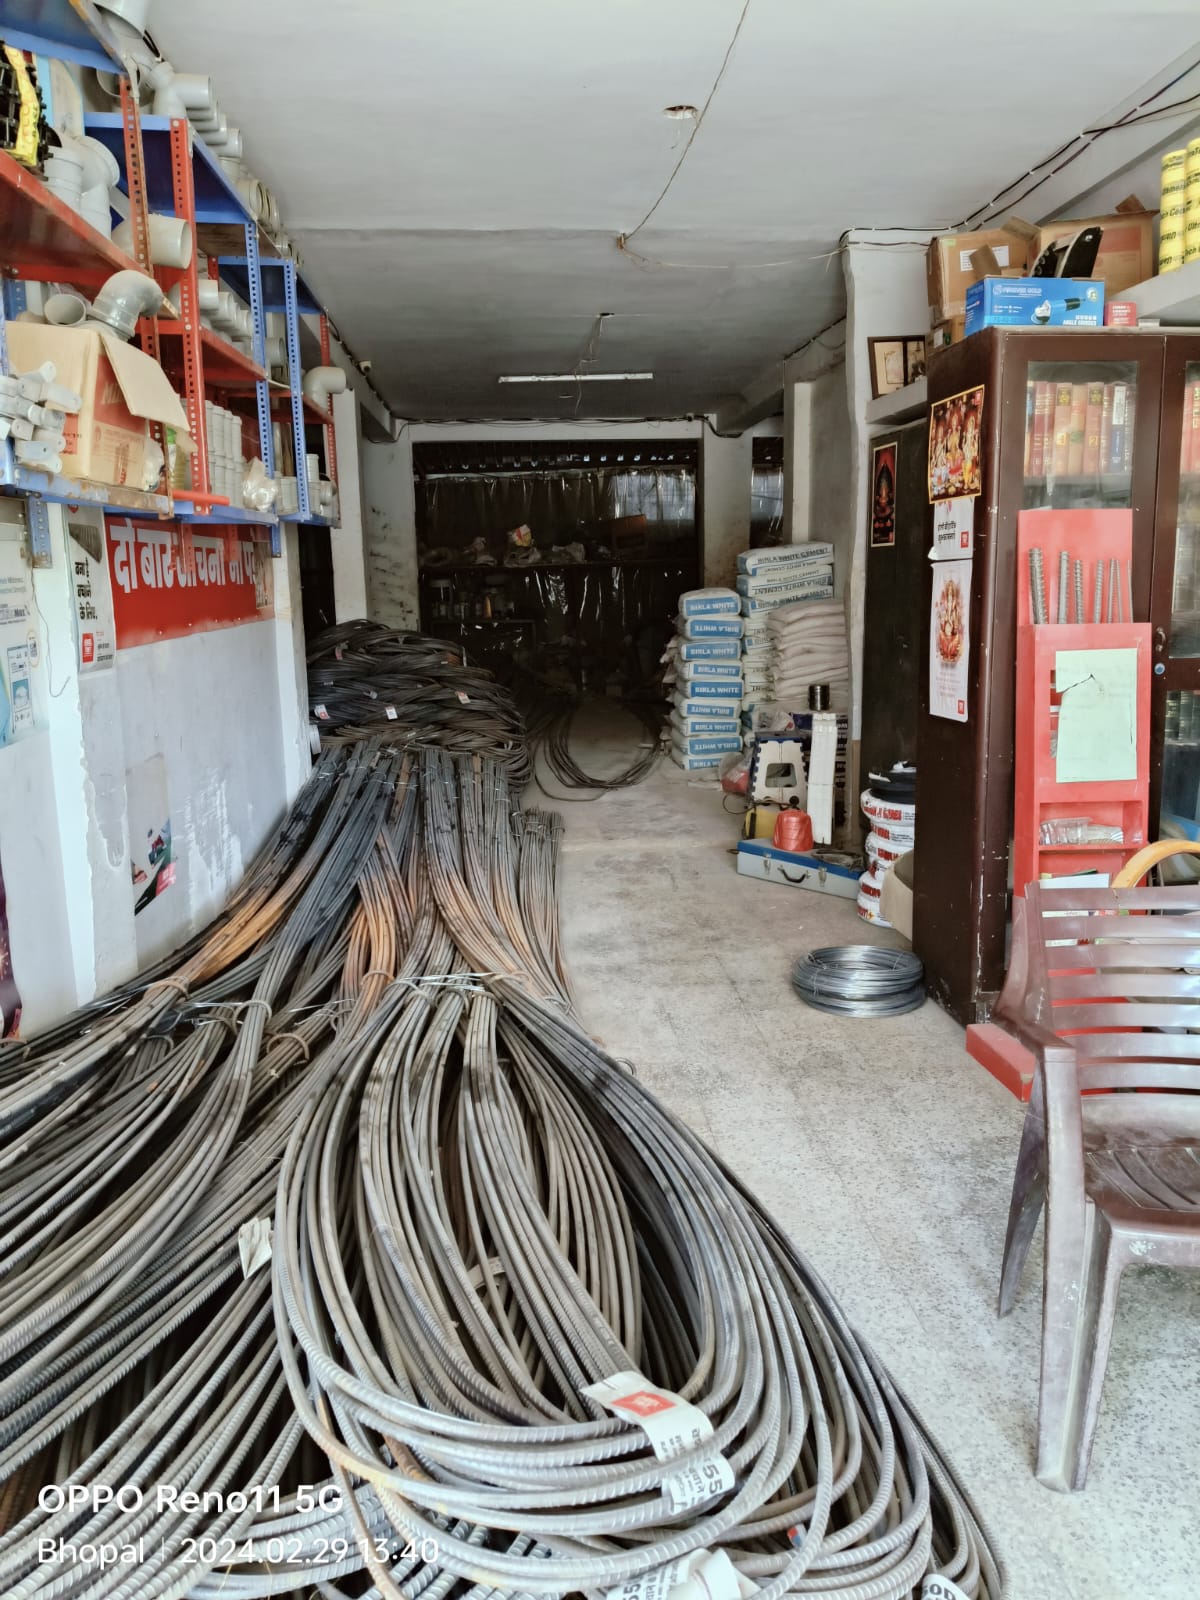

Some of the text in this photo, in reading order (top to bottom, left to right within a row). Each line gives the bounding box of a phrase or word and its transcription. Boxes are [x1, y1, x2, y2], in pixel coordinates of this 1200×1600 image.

[109, 518, 139, 594] दो
[695, 624, 740, 633] BIRLA WHITE
[690, 648, 736, 656] BIRLA WHITE
[695, 686, 740, 694] BIRLA WHITE
